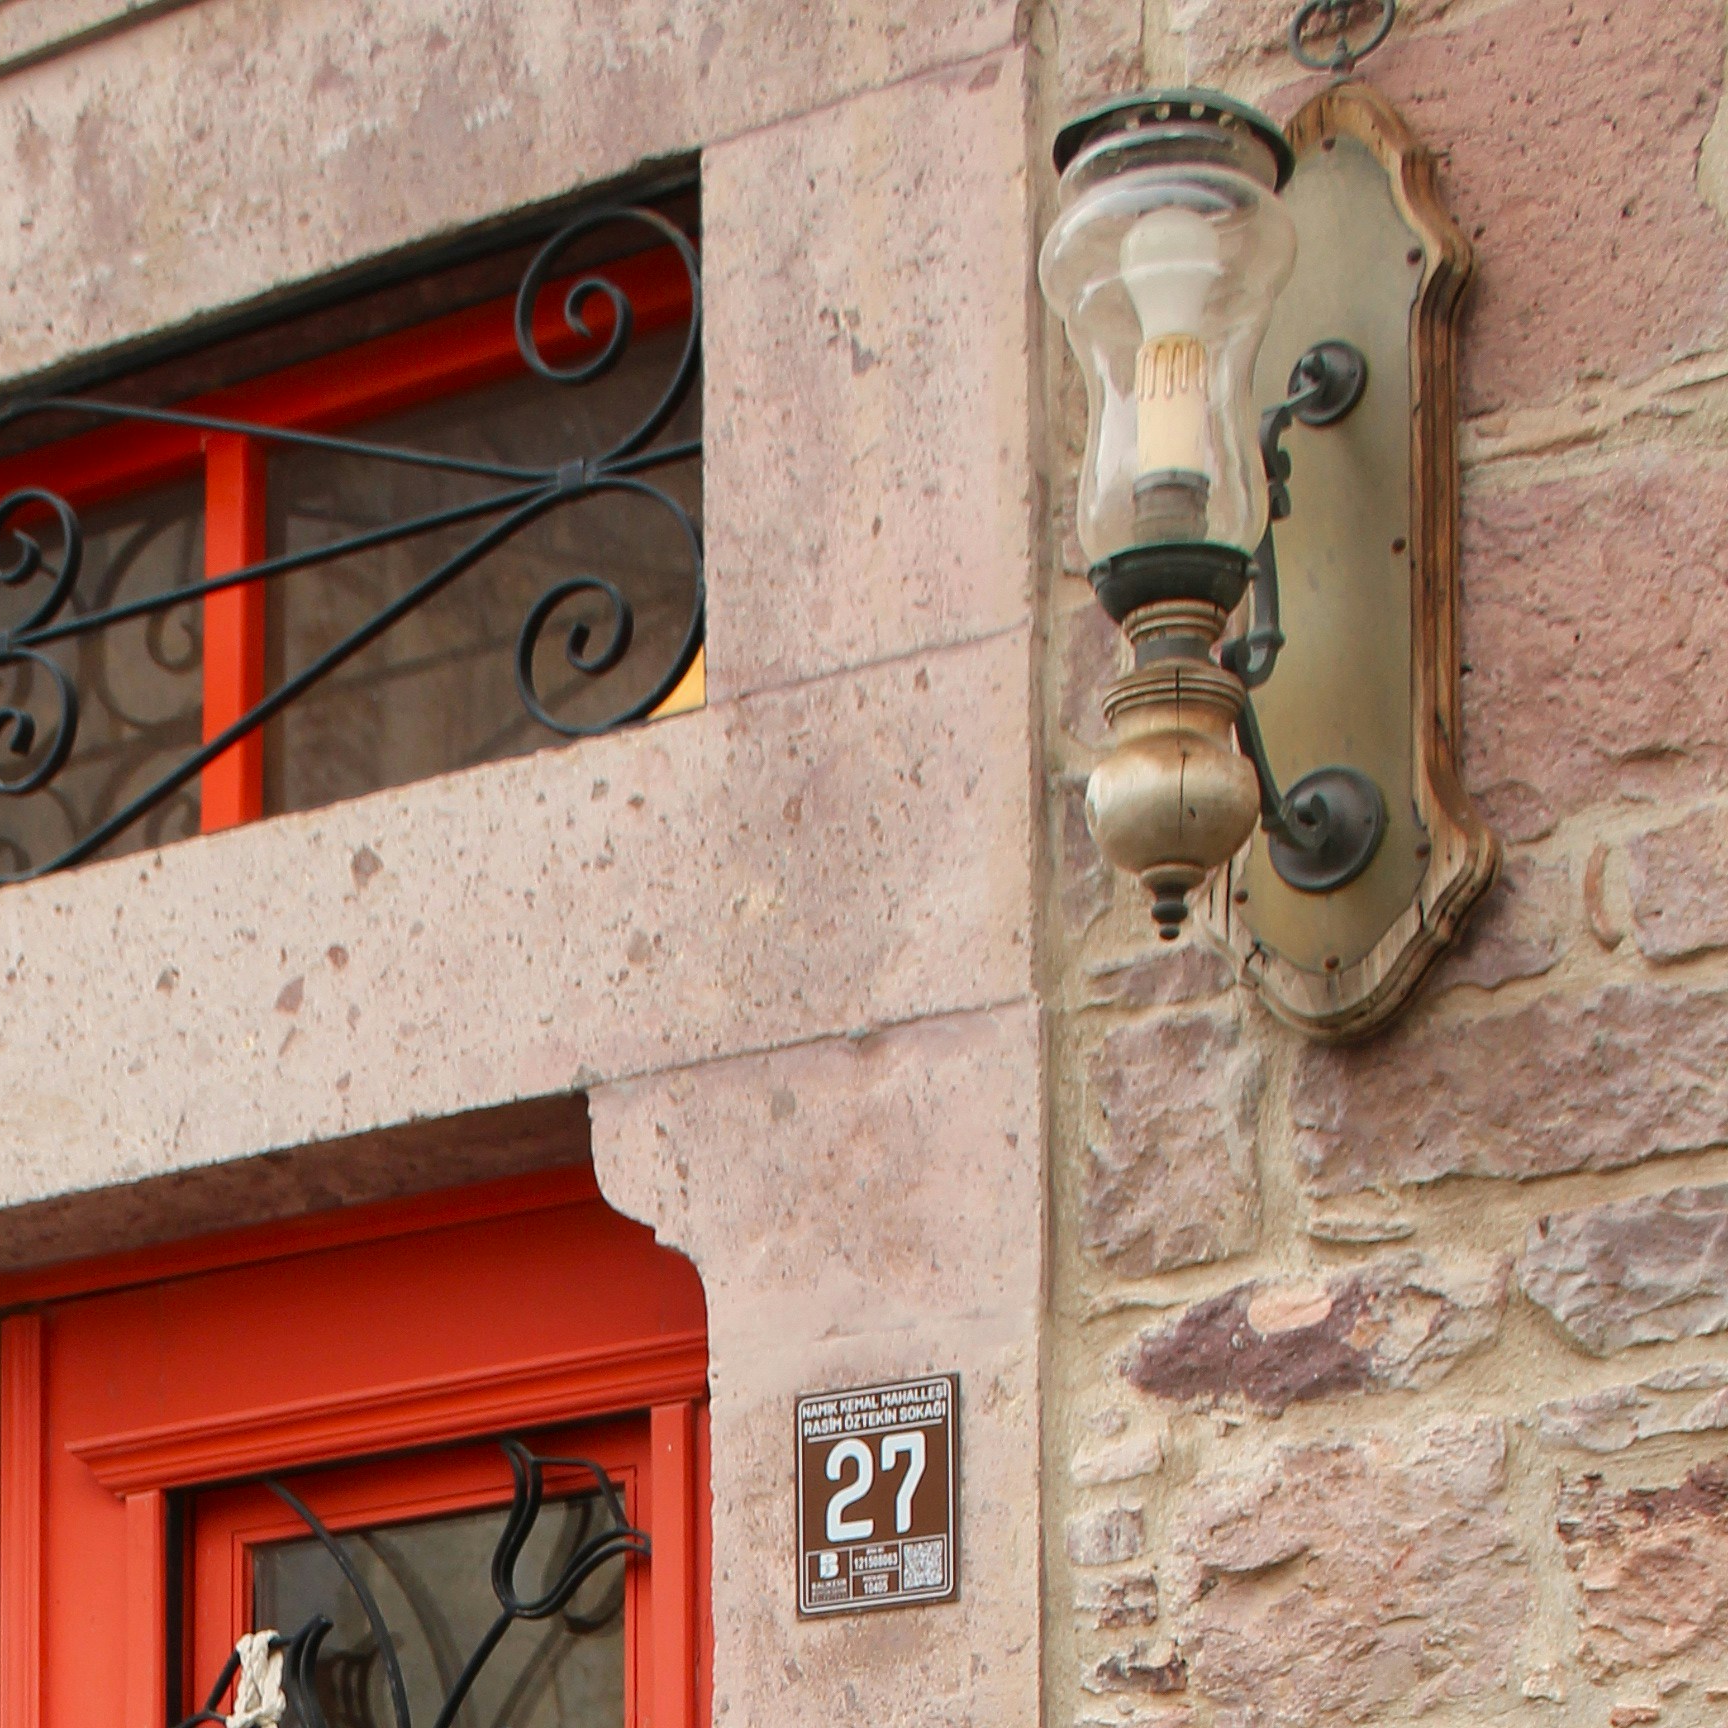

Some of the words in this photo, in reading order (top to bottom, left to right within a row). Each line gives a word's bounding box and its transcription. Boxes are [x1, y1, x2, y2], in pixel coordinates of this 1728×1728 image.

[802, 1400, 838, 1420] NAMIK
[840, 1395, 879, 1415] KEMAL
[826, 1431, 925, 1543] 27
